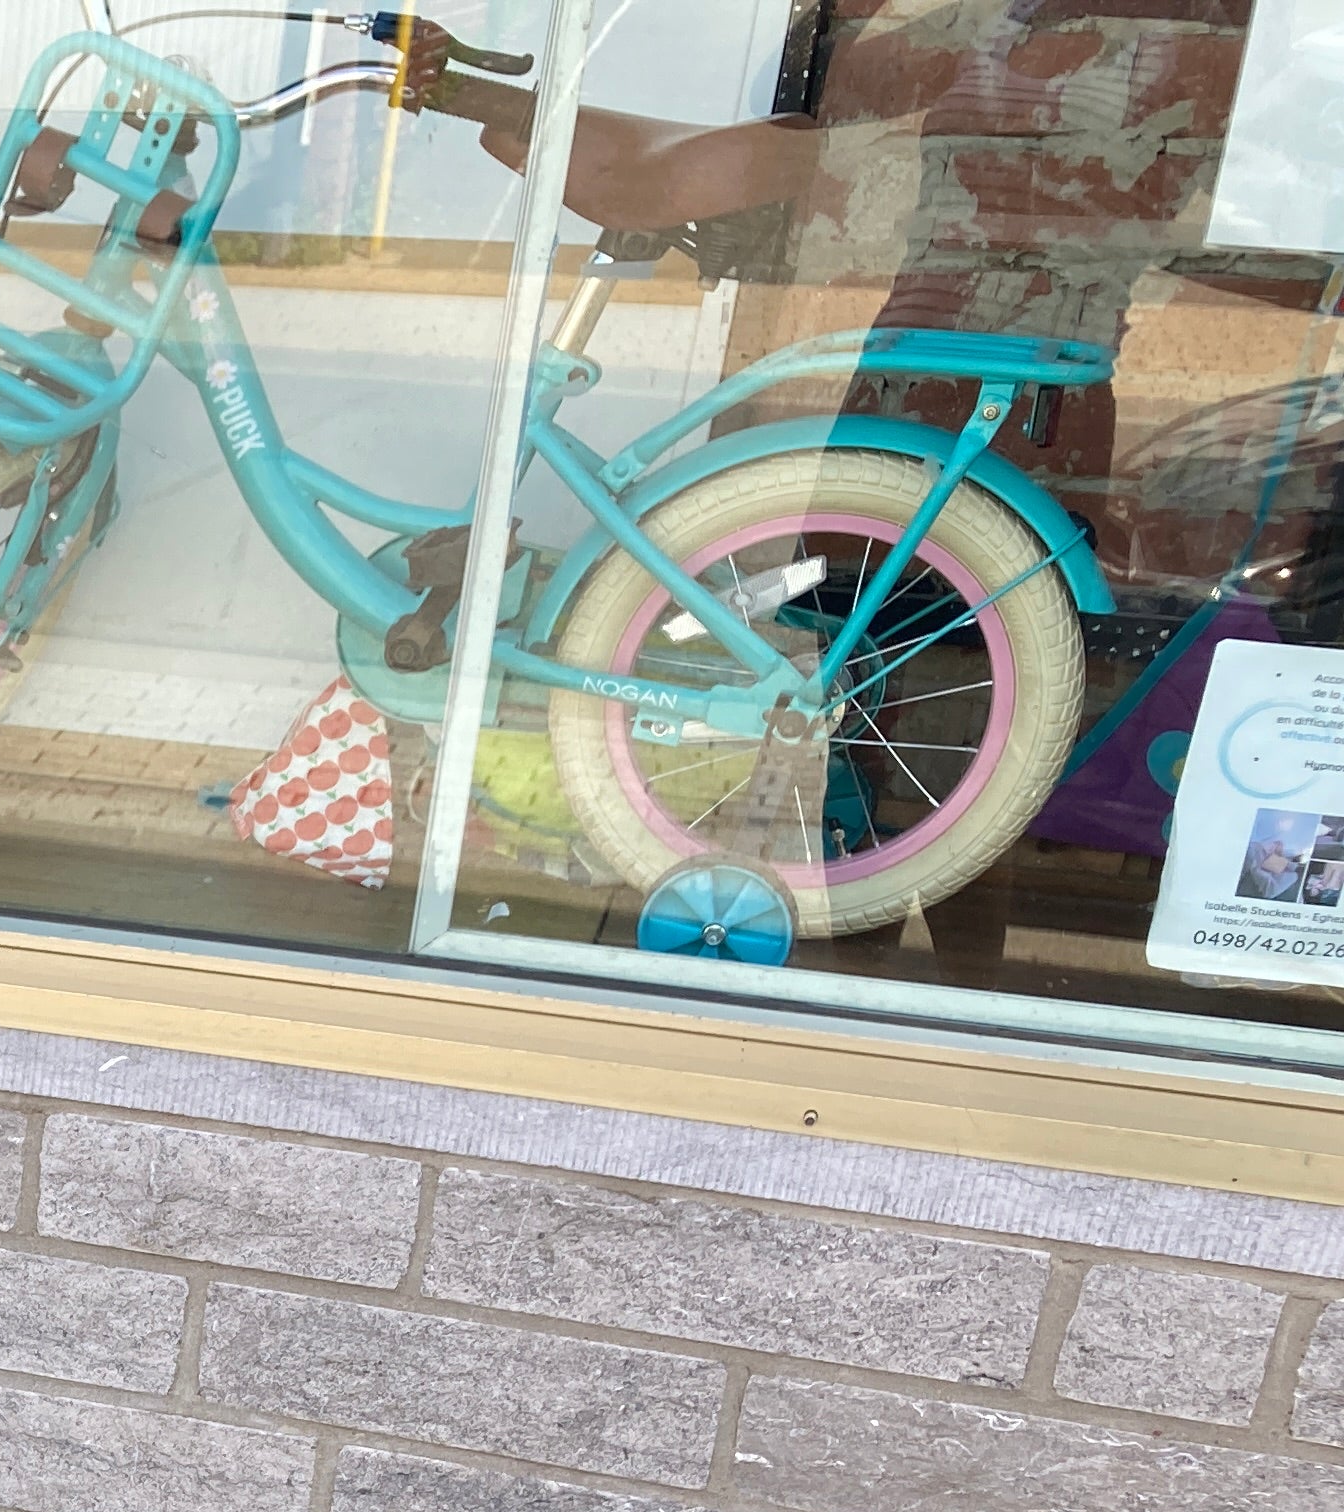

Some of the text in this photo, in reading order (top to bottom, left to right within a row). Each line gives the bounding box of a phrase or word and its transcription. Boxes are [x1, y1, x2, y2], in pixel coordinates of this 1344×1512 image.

[213, 385, 265, 460] PUCK
[582, 676, 678, 709] NOGAN
[1277, 717, 1292, 725] en
[1205, 900, 1248, 914] Isabelle
[1250, 906, 1301, 920] Stuckens
